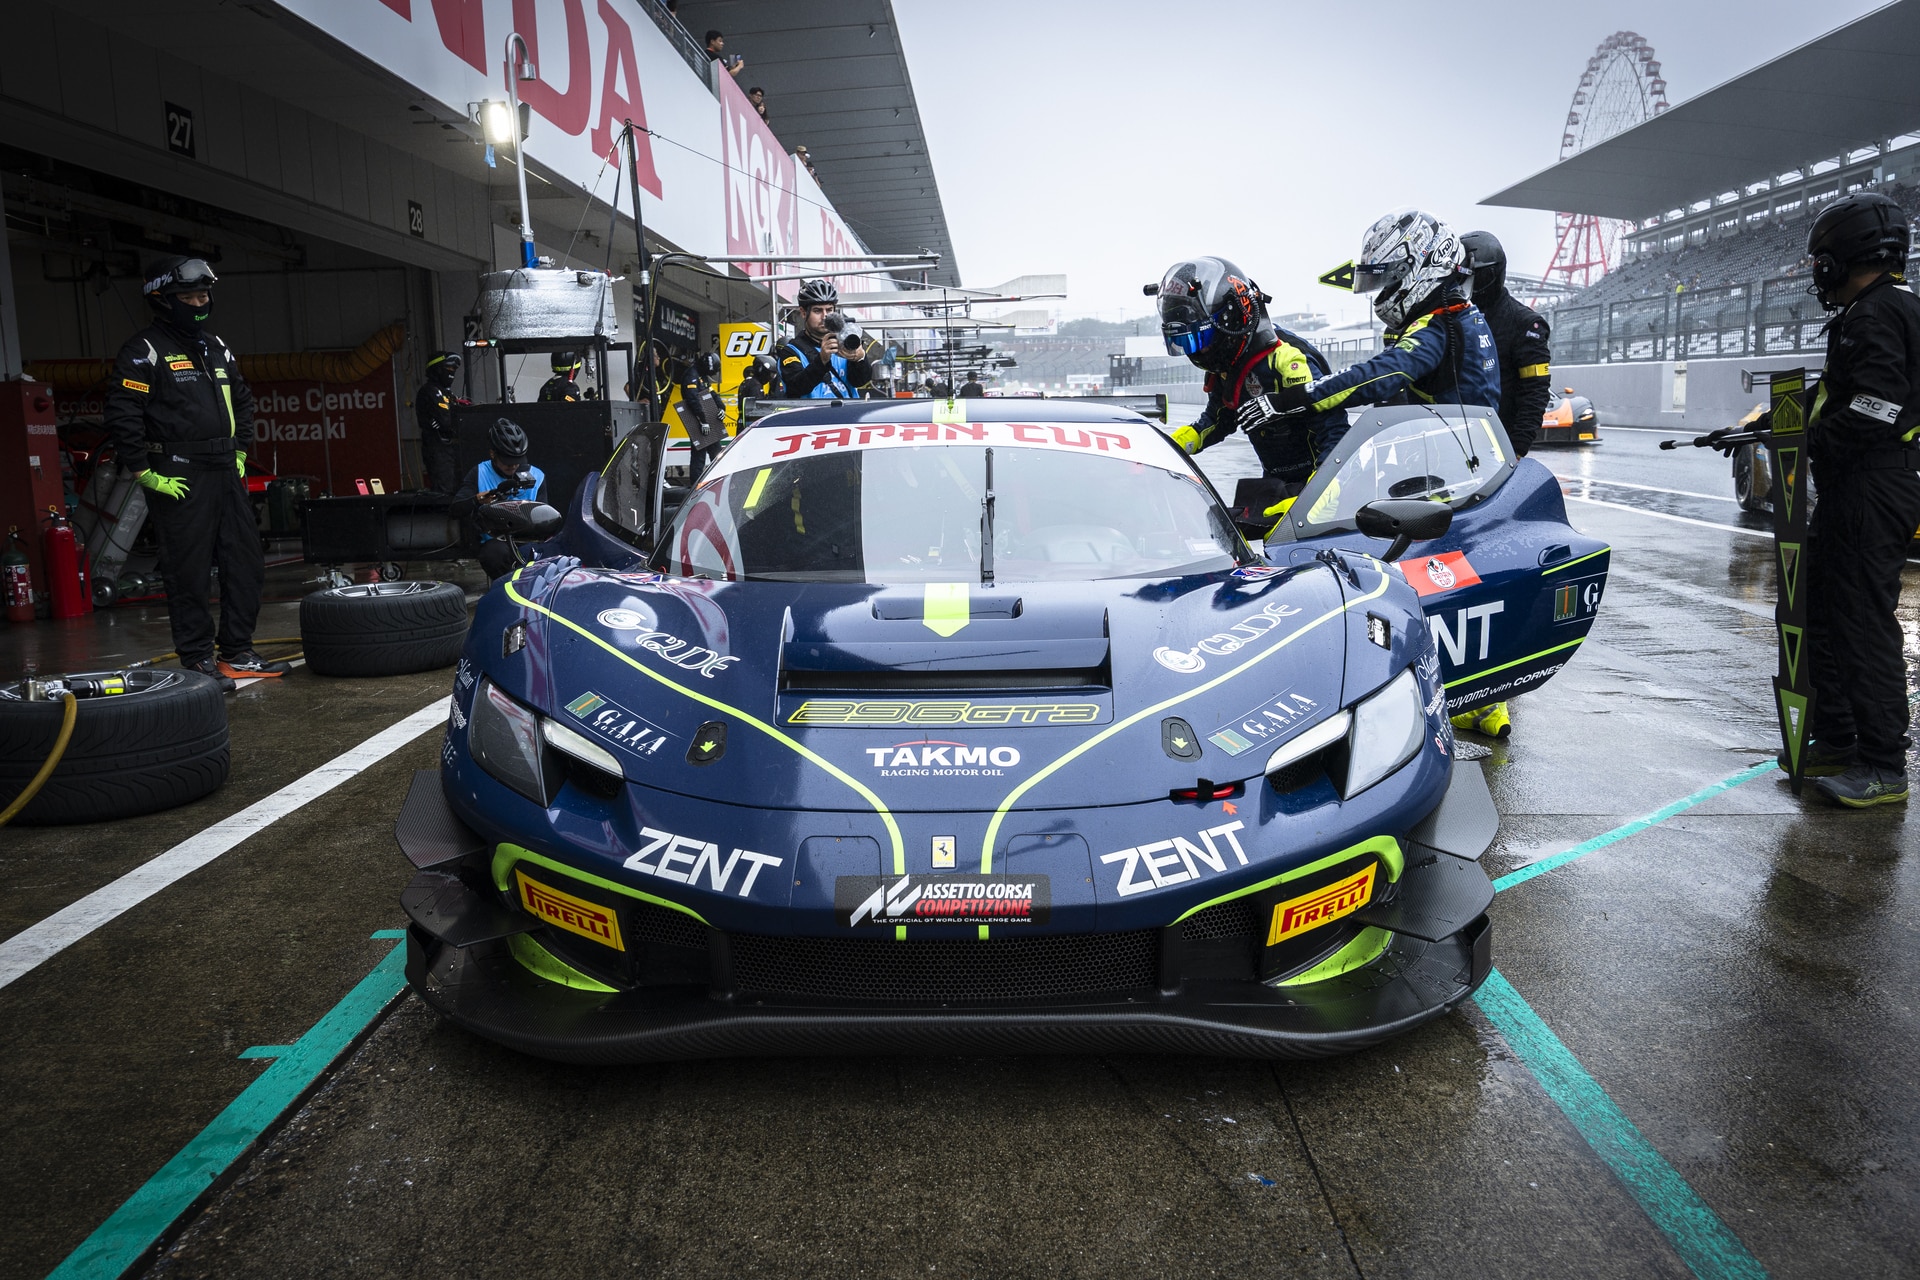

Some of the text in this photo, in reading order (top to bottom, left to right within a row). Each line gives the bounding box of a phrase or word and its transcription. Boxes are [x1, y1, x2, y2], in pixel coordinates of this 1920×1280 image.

[168, 112, 192, 150] 27
[409, 207, 424, 233] 28
[1436, 241, 1452, 262] Arai
[725, 331, 772, 357] 60
[252, 388, 386, 414] sche Center
[253, 416, 346, 443] Okazaki
[772, 423, 1131, 457] JAPAN CUP
[1425, 600, 1504, 667] NT
[1513, 663, 1564, 687] CORNES
[1242, 693, 1313, 735] GAIA
[597, 709, 667, 752] GAIA
[865, 747, 1021, 767] TAKMO
[881, 769, 929, 777] RACING
[932, 769, 979, 777] MOTOR
[622, 827, 783, 897] ZENT
[1099, 820, 1250, 897] ZENT
[922, 883, 1033, 899] ASSETTO CORSA
[1280, 874, 1369, 934] PIRELLI
[524, 882, 612, 939] PIRELLI
[915, 899, 1032, 916] COMPETIZIONE
